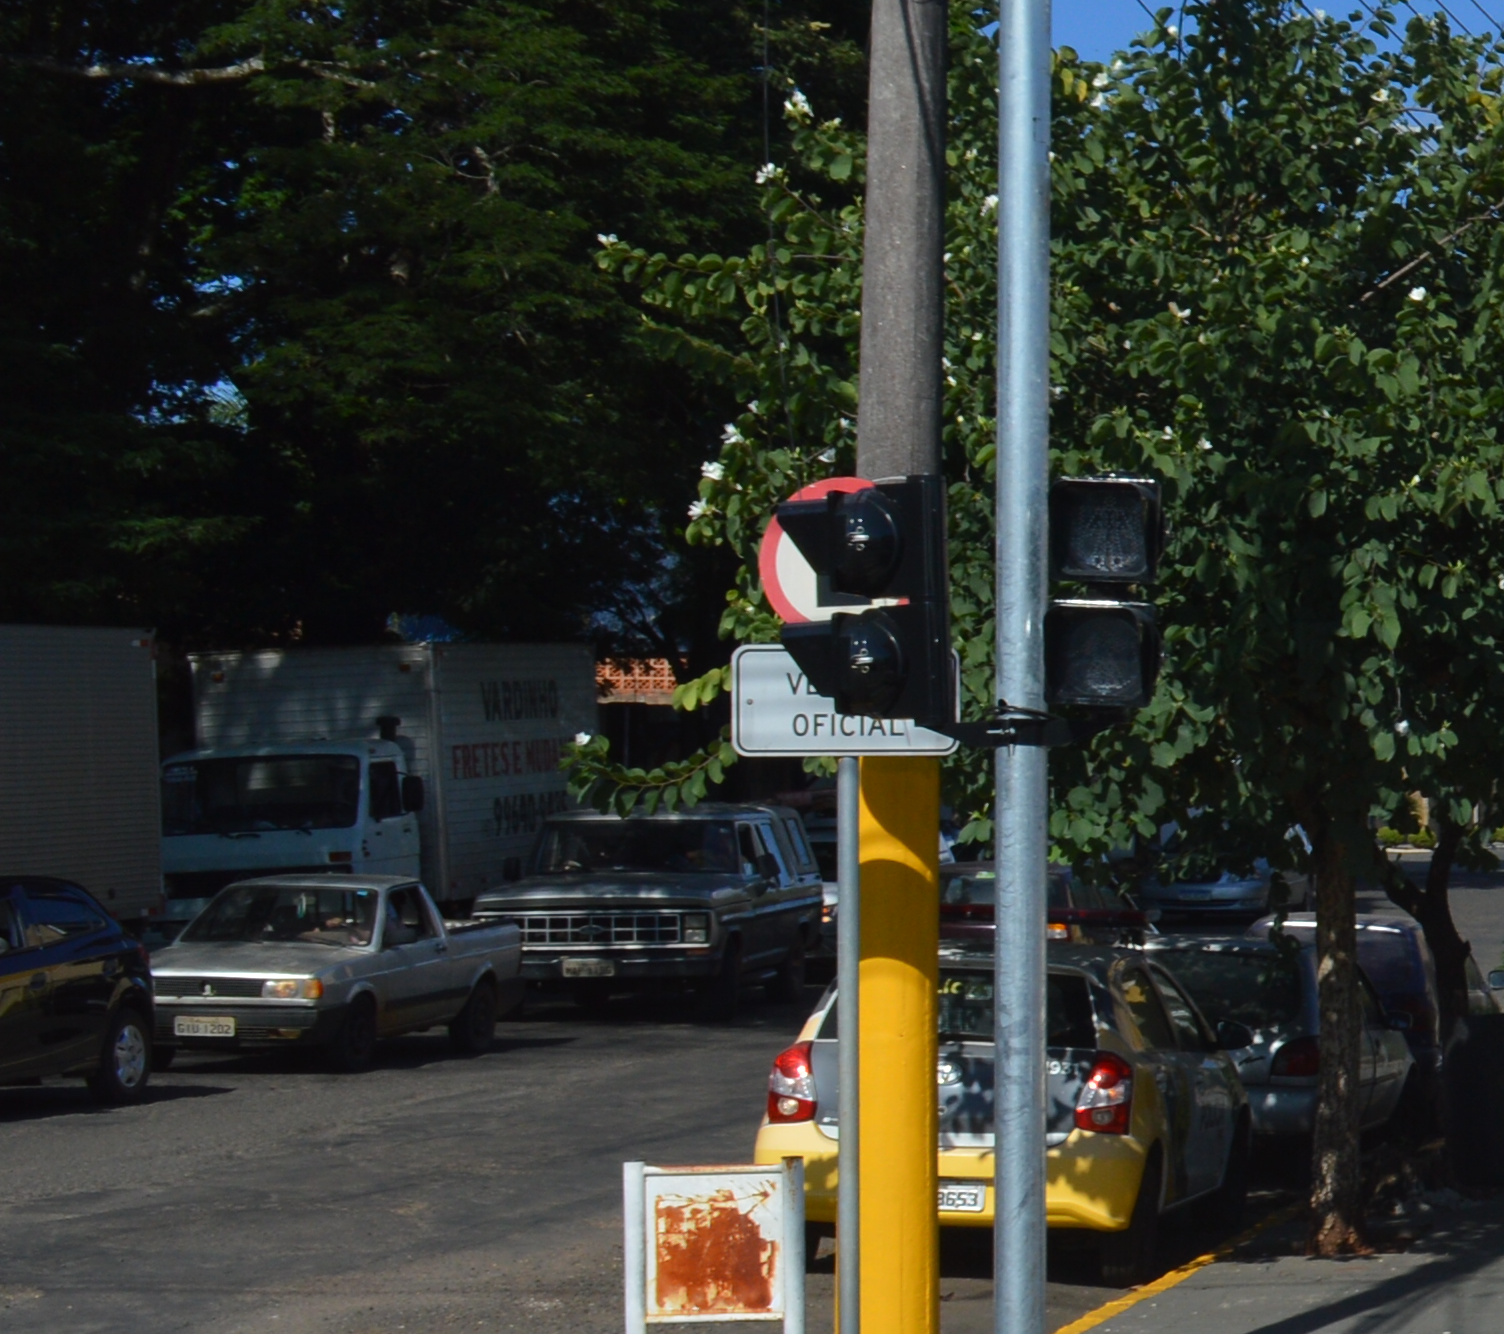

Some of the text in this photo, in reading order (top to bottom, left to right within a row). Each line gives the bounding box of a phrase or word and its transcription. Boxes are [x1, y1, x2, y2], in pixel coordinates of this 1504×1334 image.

[792, 713, 905, 737] OFICIAL
[452, 741, 510, 780] FRETES
[512, 739, 523, 776] E
